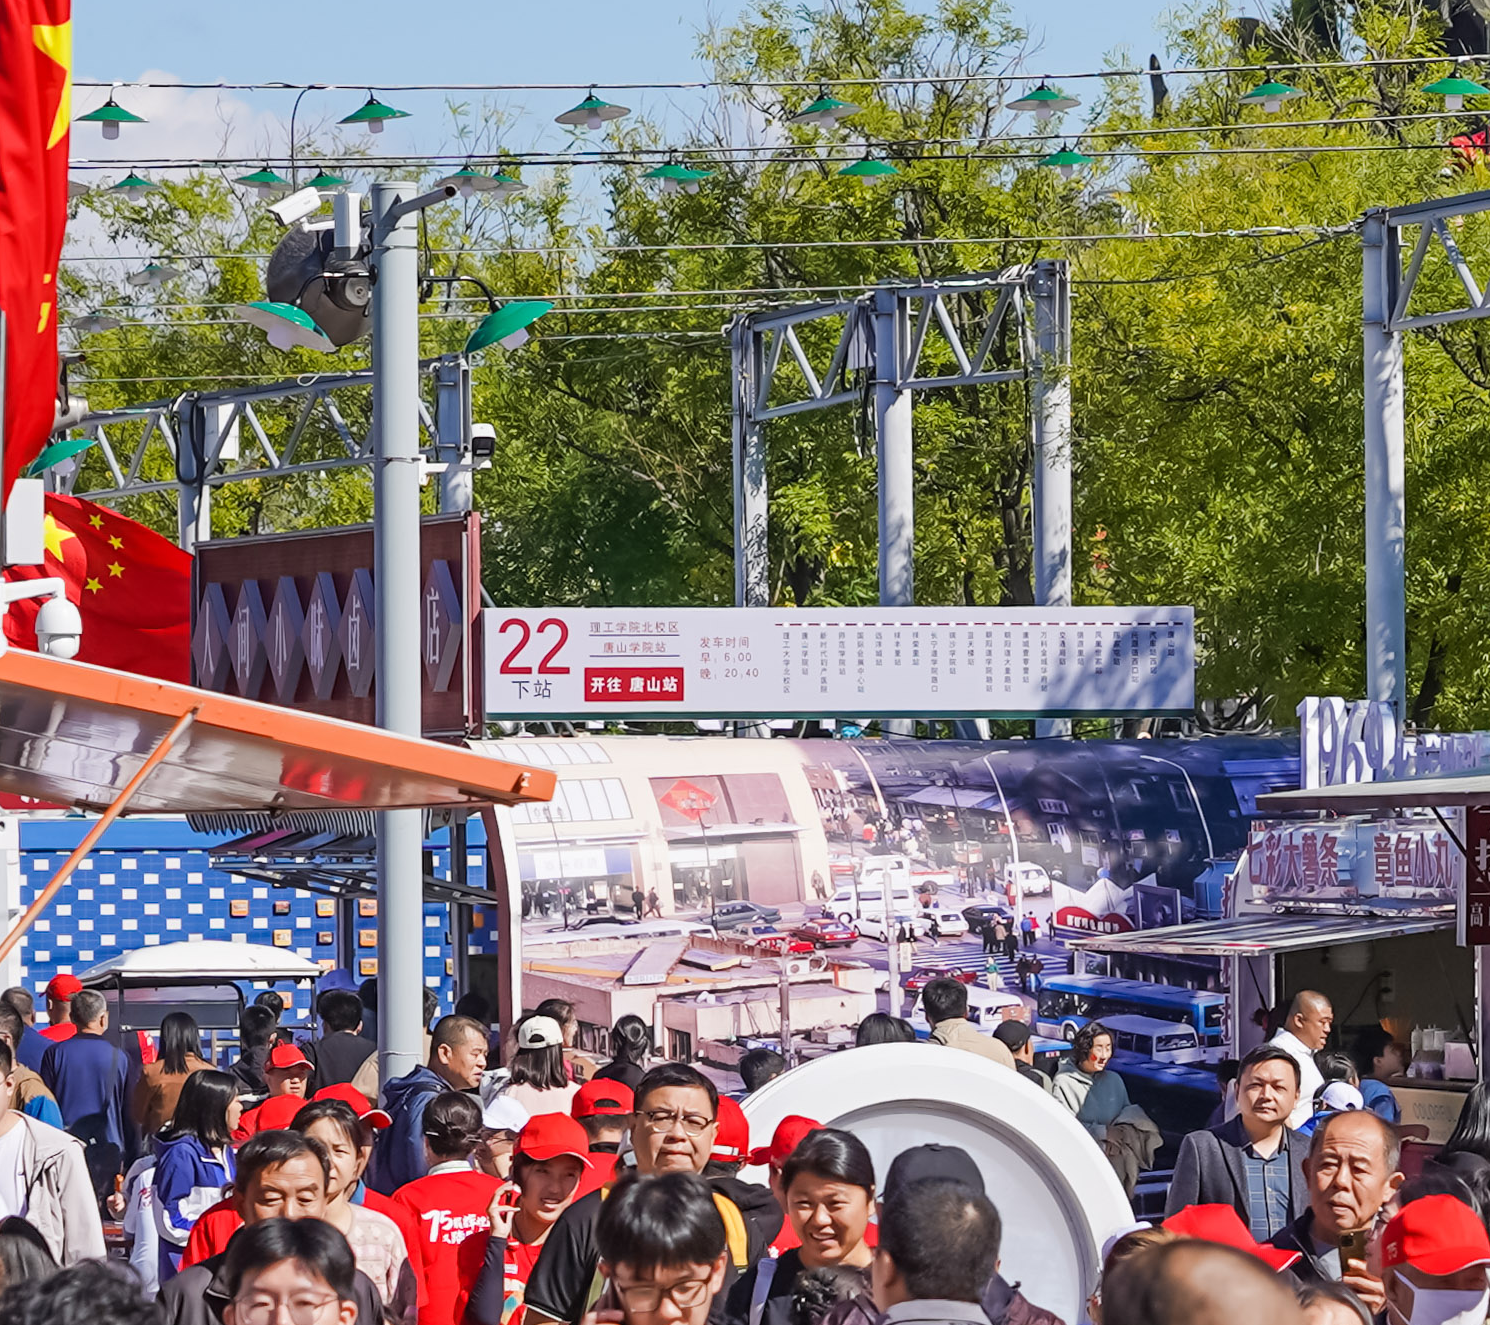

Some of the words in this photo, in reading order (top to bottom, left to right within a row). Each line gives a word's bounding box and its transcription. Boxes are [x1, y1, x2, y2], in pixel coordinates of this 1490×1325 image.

[202, 587, 440, 674] 人间小味卤店
[498, 618, 570, 675] 22
[604, 641, 666, 653] 唐山学院站
[700, 636, 750, 649] 发车时间
[511, 680, 553, 699] 下站
[590, 677, 623, 693] 开往
[629, 677, 678, 693] 唐山站
